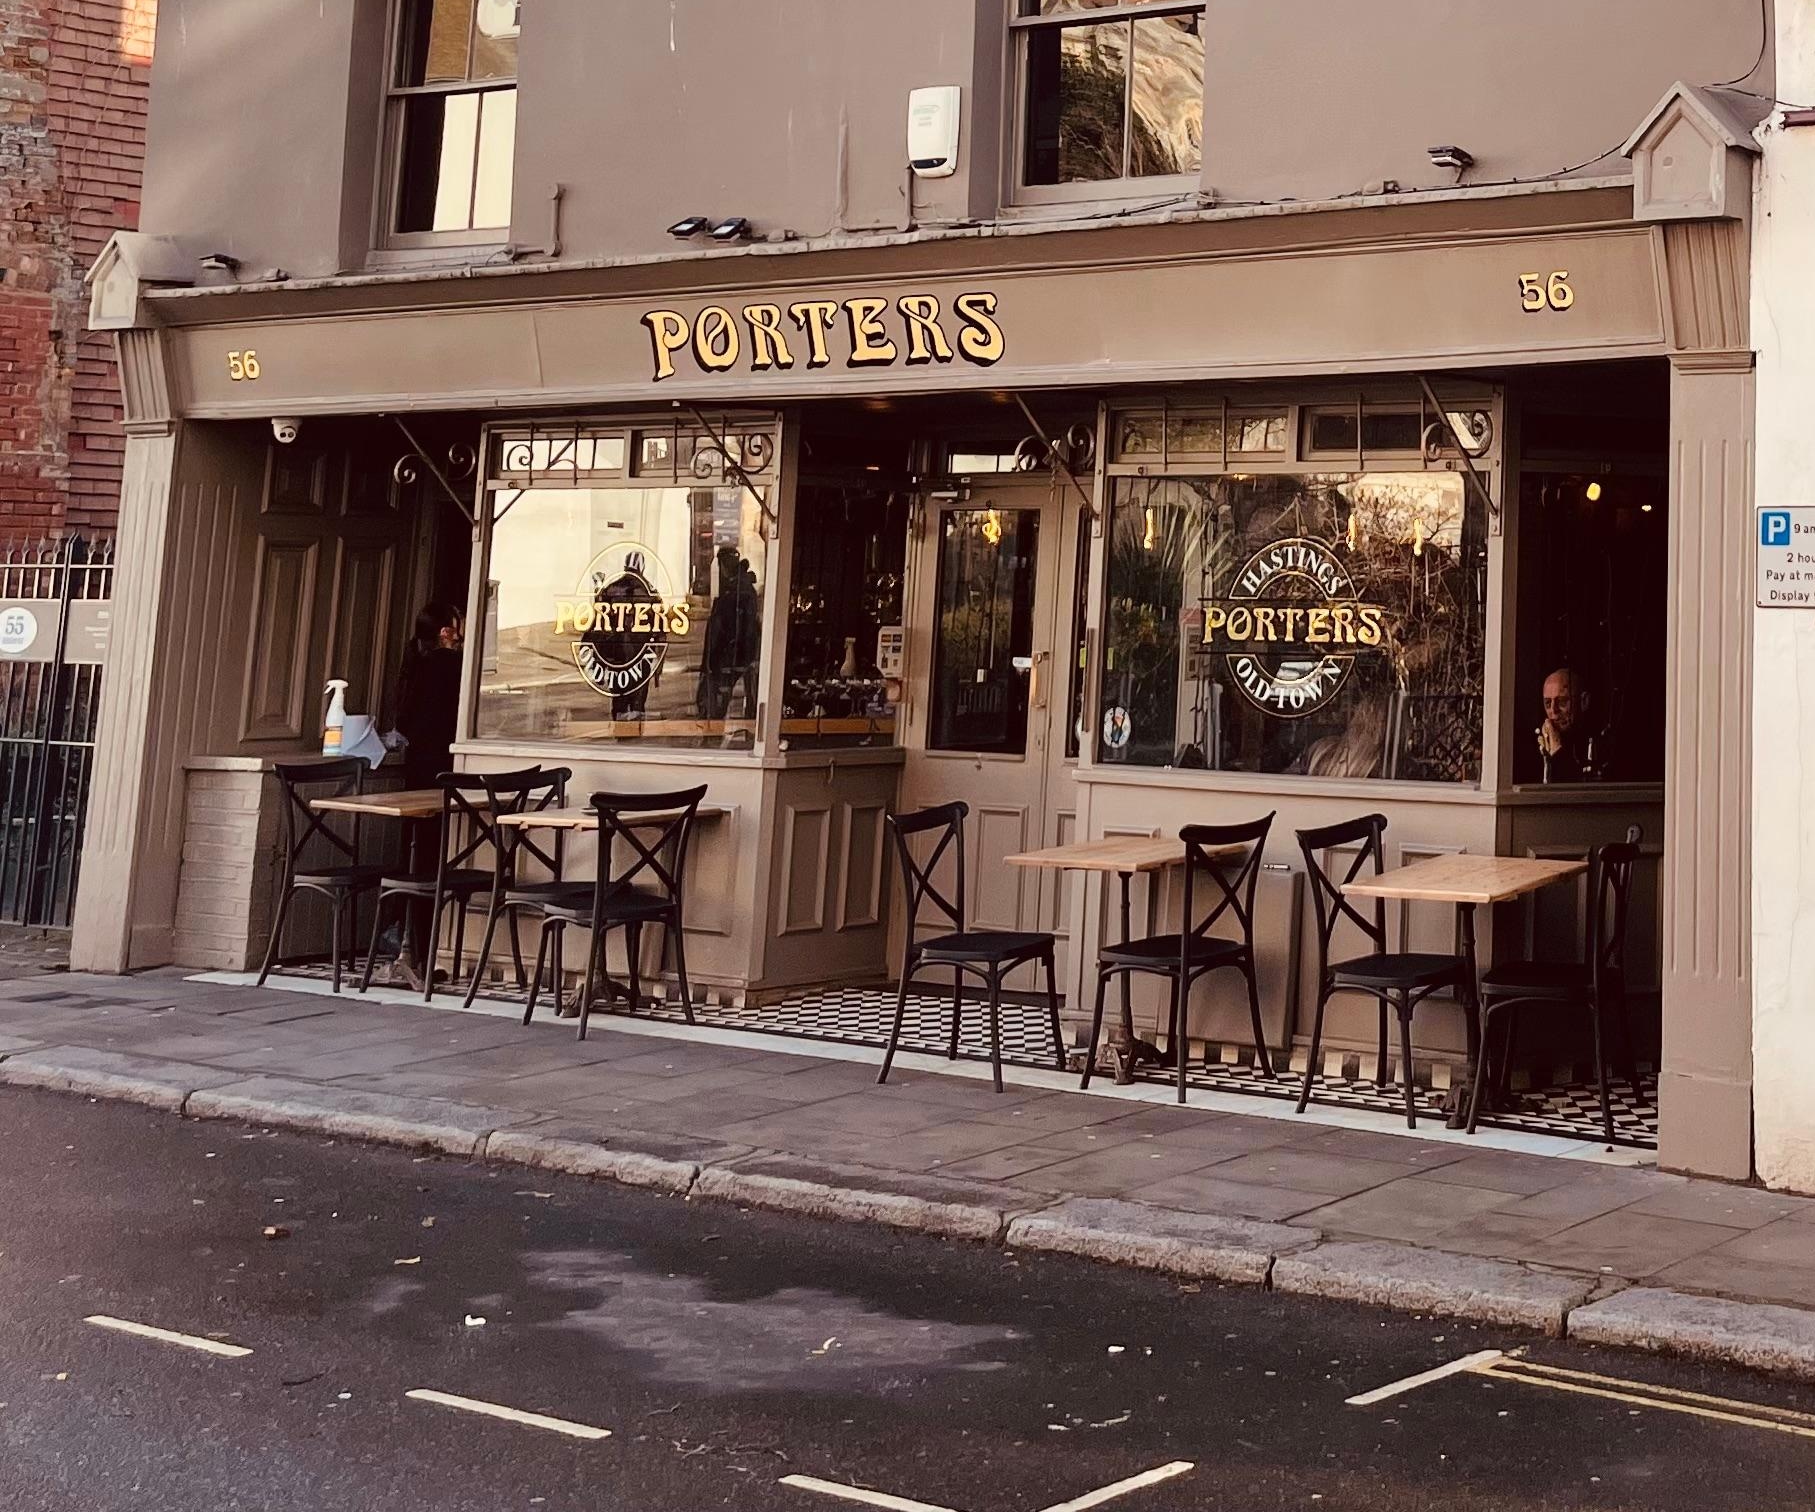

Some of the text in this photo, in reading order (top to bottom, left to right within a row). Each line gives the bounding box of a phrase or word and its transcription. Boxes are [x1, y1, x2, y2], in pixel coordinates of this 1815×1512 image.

[1518, 270, 1575, 313] 56
[641, 292, 1005, 382] PORTERS
[228, 350, 260, 381] 56
[1768, 515, 1787, 543] P
[1241, 546, 1348, 595] HASTINGS
[1786, 553, 1794, 563] 2
[1766, 570, 1785, 582] Pay
[1789, 570, 1800, 580] at
[1770, 590, 1810, 602] Display
[5, 615, 25, 635] 55
[554, 601, 690, 635] PORTERS
[1202, 606, 1382, 646] PORTERS
[578, 646, 658, 689] OLD TOWN
[1236, 657, 1342, 709] OLD TOWN
